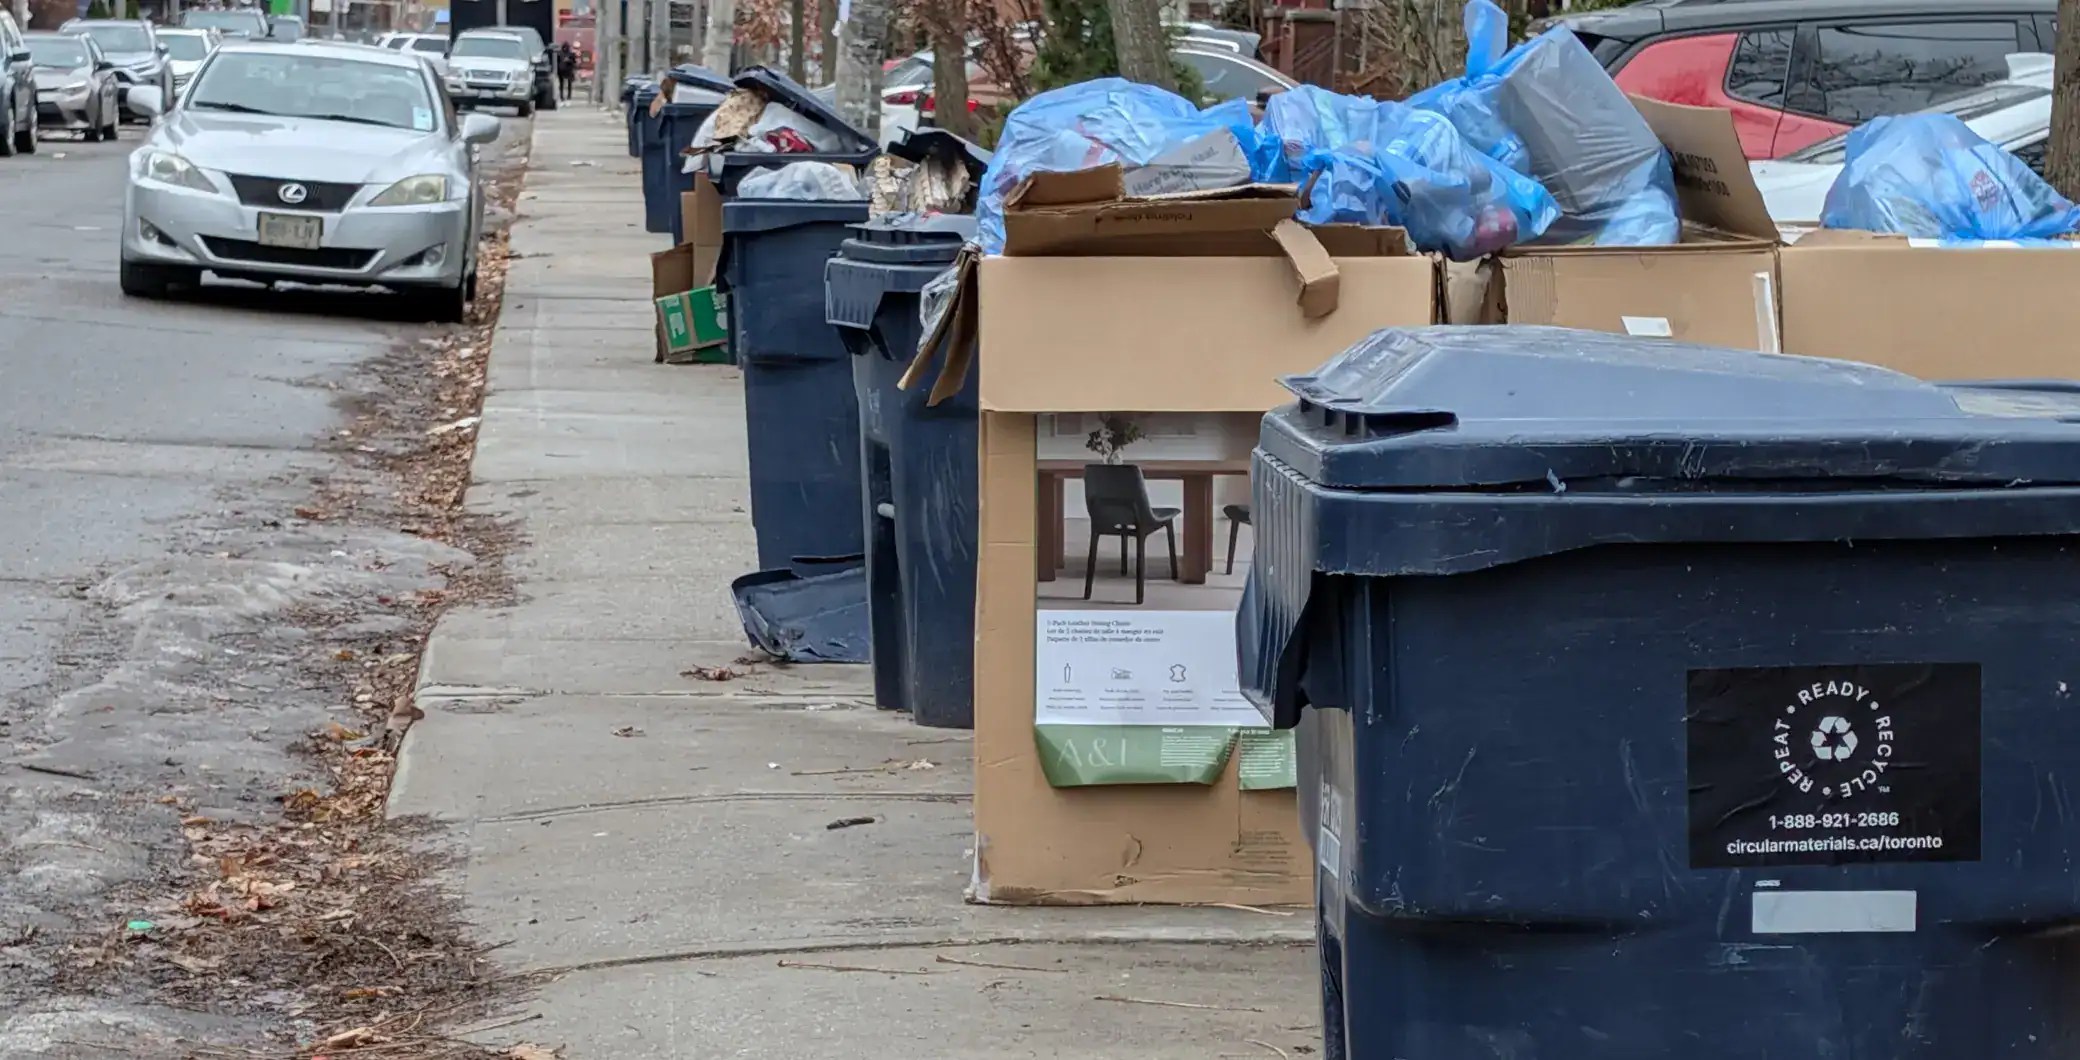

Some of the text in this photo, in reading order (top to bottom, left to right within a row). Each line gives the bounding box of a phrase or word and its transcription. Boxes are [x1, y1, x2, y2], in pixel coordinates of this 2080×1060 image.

[1797, 680, 1870, 706] READY
[1774, 718, 1815, 794] REPEAT
[1839, 715, 1894, 799] RECYCLE
[1768, 811, 1900, 830] 1-888-921-2686
[1726, 834, 1943, 855] circularmaterials.ca/toronto
